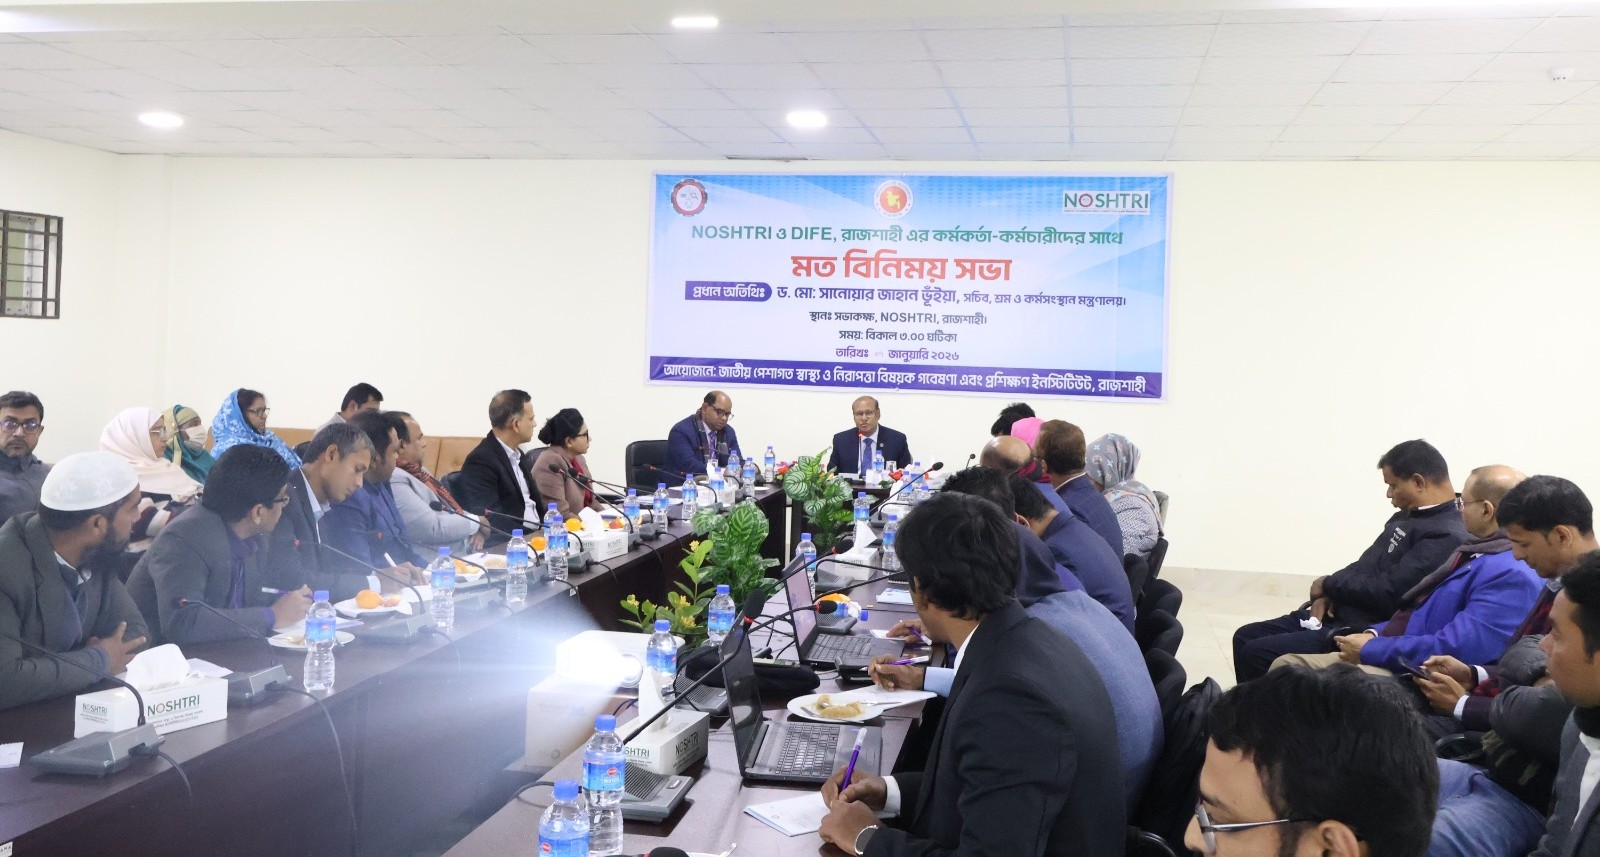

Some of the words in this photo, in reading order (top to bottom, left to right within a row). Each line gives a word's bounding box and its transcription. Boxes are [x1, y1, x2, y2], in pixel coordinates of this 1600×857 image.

[1064, 193, 1149, 208] NOSHTRI
[691, 225, 772, 240] NOSHTRI
[776, 228, 787, 240] ও
[791, 226, 837, 243] DIFE,
[841, 225, 903, 243] রাজশাহী
[906, 230, 930, 243] এর
[932, 225, 1086, 245] কর্মকর্তা-কর্মচারীদের
[1089, 231, 1123, 244] সাথে
[791, 256, 838, 278] মত
[843, 248, 948, 283] বিনিময়
[954, 258, 1013, 281] সভা
[693, 286, 721, 298] প্রধান
[723, 283, 766, 298] অতিথিঃ
[777, 286, 791, 298] ড.
[794, 287, 816, 299] মো:
[819, 287, 875, 302] সানোয়ার
[877, 288, 919, 302] জাহান
[921, 286, 960, 307] ভূঁইয়া,
[963, 291, 991, 304] সচিব,
[994, 294, 1011, 303] শ্রম
[1013, 294, 1022, 304] ও
[1024, 292, 1076, 306] কর্মসংস্থান
[1078, 296, 1126, 307] মন্ত্রণালয়।
[809, 311, 832, 322] স্থানঃ
[834, 311, 878, 324] সভাকক্ষ,
[880, 312, 940, 324] NOSHTRI,
[942, 312, 987, 325] রাজশাহী।
[838, 330, 863, 341] সময়:
[865, 328, 897, 341] বিকাল
[899, 332, 925, 341] ৩.০০
[927, 329, 957, 343] ঘটিকা
[836, 346, 869, 358] তারিখঃ
[888, 347, 929, 363] জানুয়ারি
[931, 352, 960, 361] ২০২৬
[663, 364, 717, 378] আয়োজনে:
[719, 362, 752, 379] জাতীয়
[753, 367, 794, 380] পেশাগত
[796, 368, 821, 383] স্বাস্থ্য
[823, 370, 831, 381] ও
[833, 366, 876, 383] নিরাপত্তা
[877, 368, 916, 385] বিষয়ক
[918, 373, 957, 385] গবেষণা
[959, 374, 983, 386] এবং
[985, 372, 1030, 388] প্রশিক্ষণ
[1031, 373, 1095, 392] ইনস্টিটিউট,
[1098, 376, 1147, 393] রাজশাহী
[82, 702, 107, 715] NOSHTRI
[147, 694, 200, 716] NOSHTRI
[624, 746, 650, 757] SHTRI
